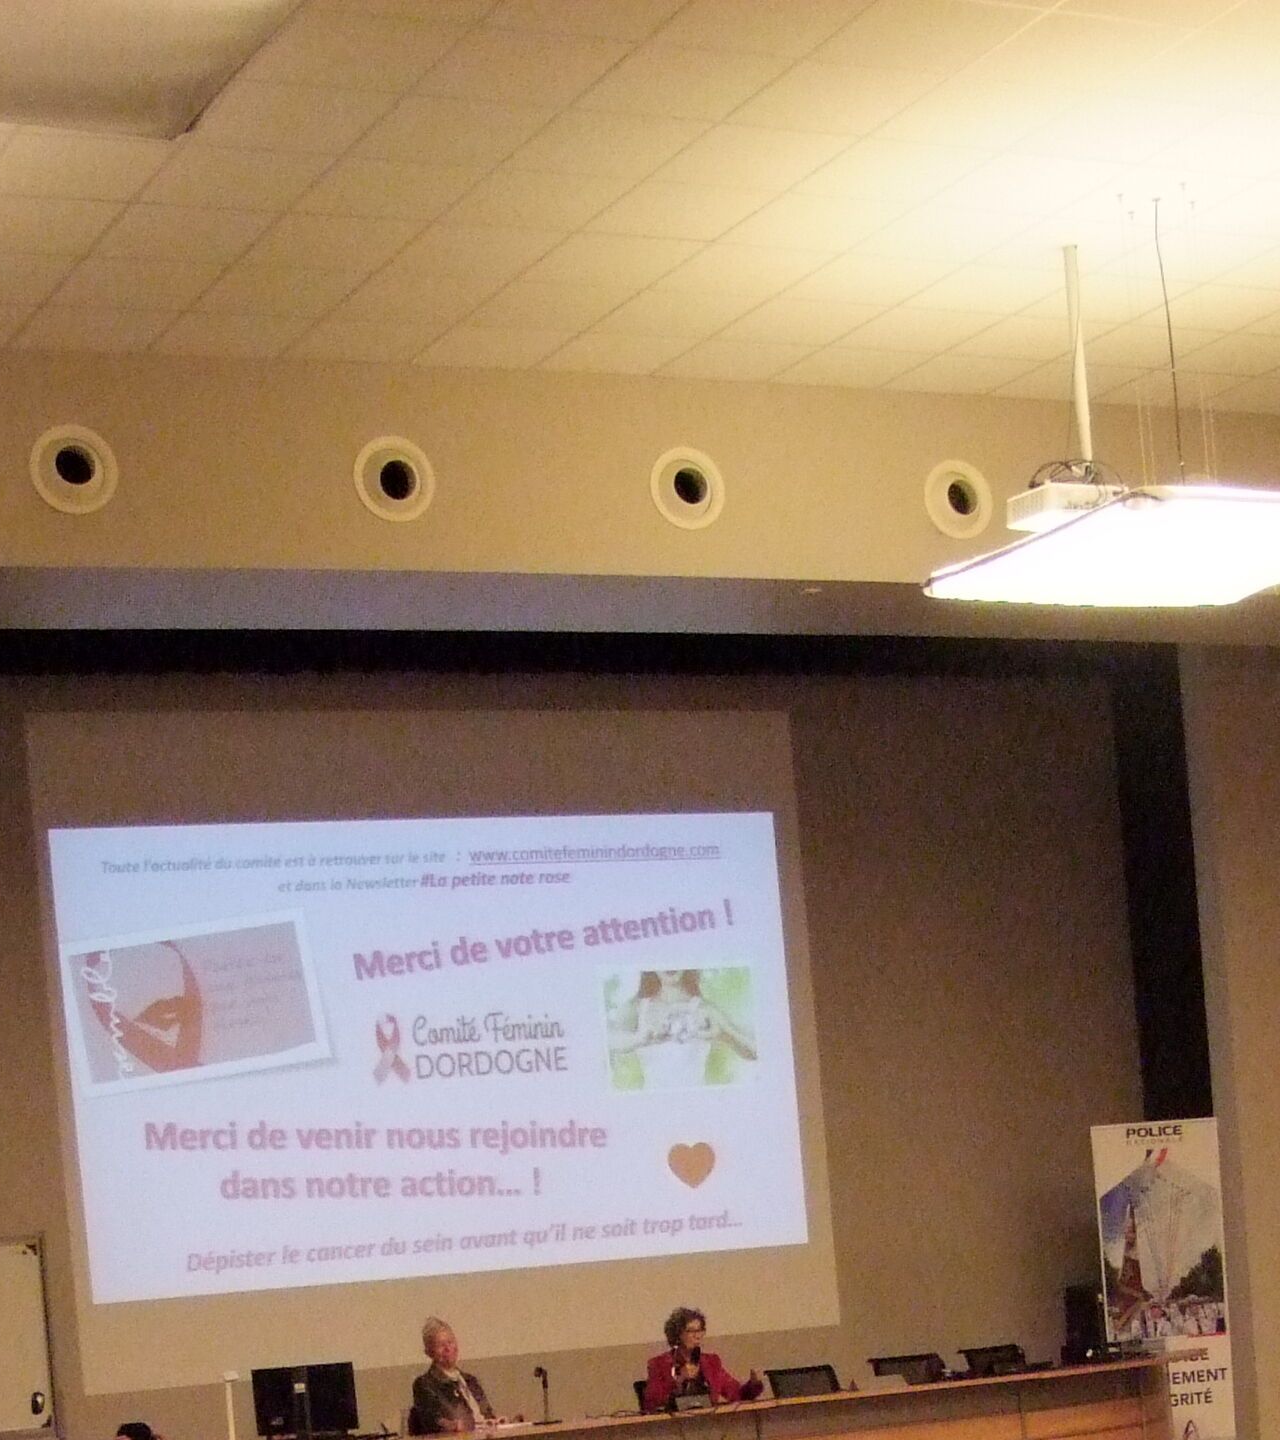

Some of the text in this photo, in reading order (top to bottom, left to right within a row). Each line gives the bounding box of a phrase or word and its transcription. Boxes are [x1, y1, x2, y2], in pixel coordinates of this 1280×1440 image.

[101, 860, 138, 874] Toute
[214, 856, 232, 870] du
[320, 853, 381, 867] retrouver
[385, 853, 404, 865] sur
[422, 851, 446, 864] site
[277, 880, 293, 893] et
[294, 879, 326, 892] dans
[346, 876, 418, 890] Newsletter
[420, 873, 447, 888] #La
[451, 872, 497, 890] petite
[500, 872, 536, 885] note
[538, 871, 571, 885] rose
[352, 940, 443, 981] Merci
[450, 936, 488, 966] de
[495, 927, 575, 960] votre
[583, 906, 716, 948] attention
[412, 1011, 566, 1047] Comité Féminin
[415, 1046, 569, 1080] DORDOGNE
[144, 1119, 608, 1157] Merci de venir nous rejoindre
[1126, 1124, 1183, 1139] POLICE
[220, 1169, 297, 1200] dans
[306, 1172, 391, 1199] notre
[400, 1168, 521, 1198] action...
[187, 1249, 276, 1274] Dépister
[281, 1245, 300, 1264] le
[306, 1240, 377, 1263] cancer
[381, 1236, 406, 1257] du
[412, 1233, 453, 1254] sein
[459, 1229, 517, 1251] avant
[572, 1223, 595, 1240] ne
[601, 1218, 636, 1239] soit
[643, 1214, 684, 1237] trop
